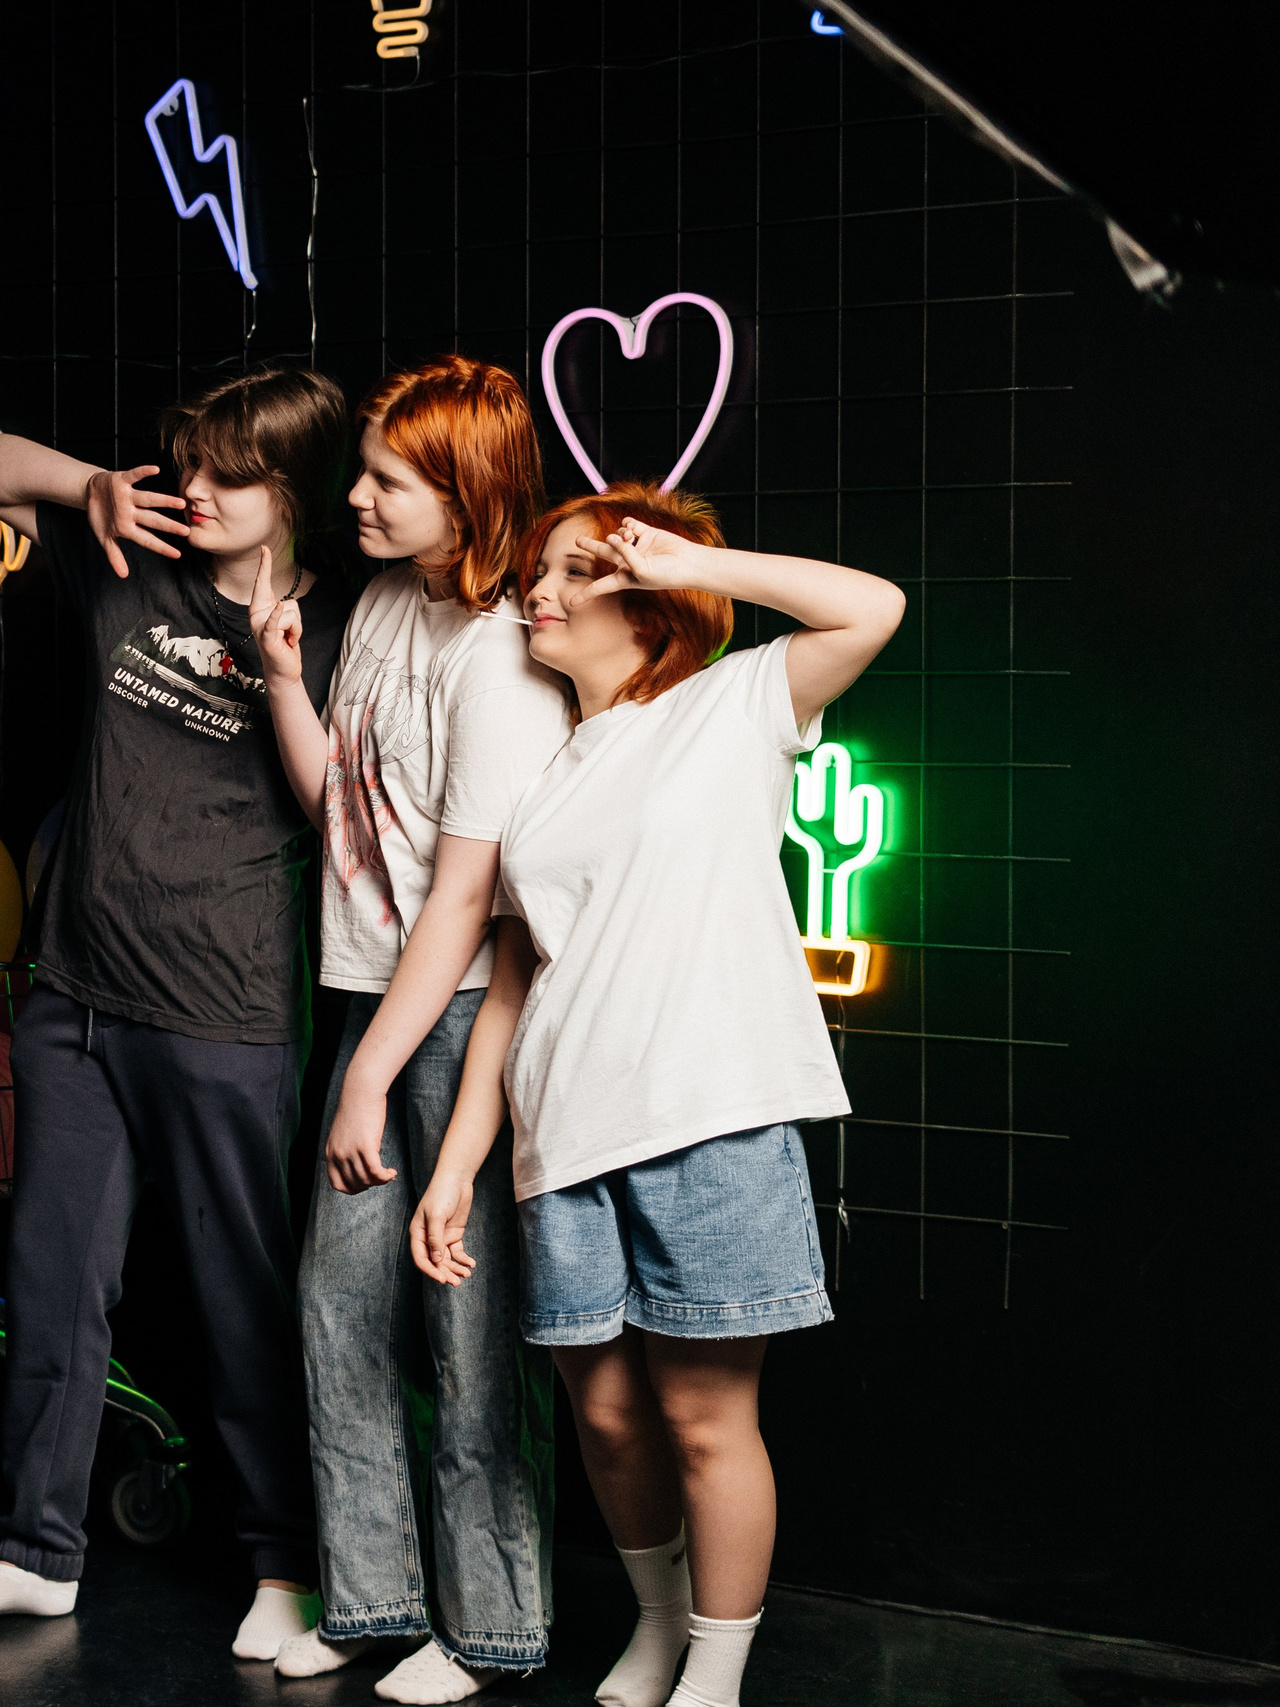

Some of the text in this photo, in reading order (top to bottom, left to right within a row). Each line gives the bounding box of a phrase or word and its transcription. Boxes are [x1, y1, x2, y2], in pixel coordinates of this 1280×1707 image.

[107, 682, 149, 709] DISCOVER
[113, 667, 244, 735] UNTAMED NATURE
[184, 719, 231, 743] UNKNOWN
